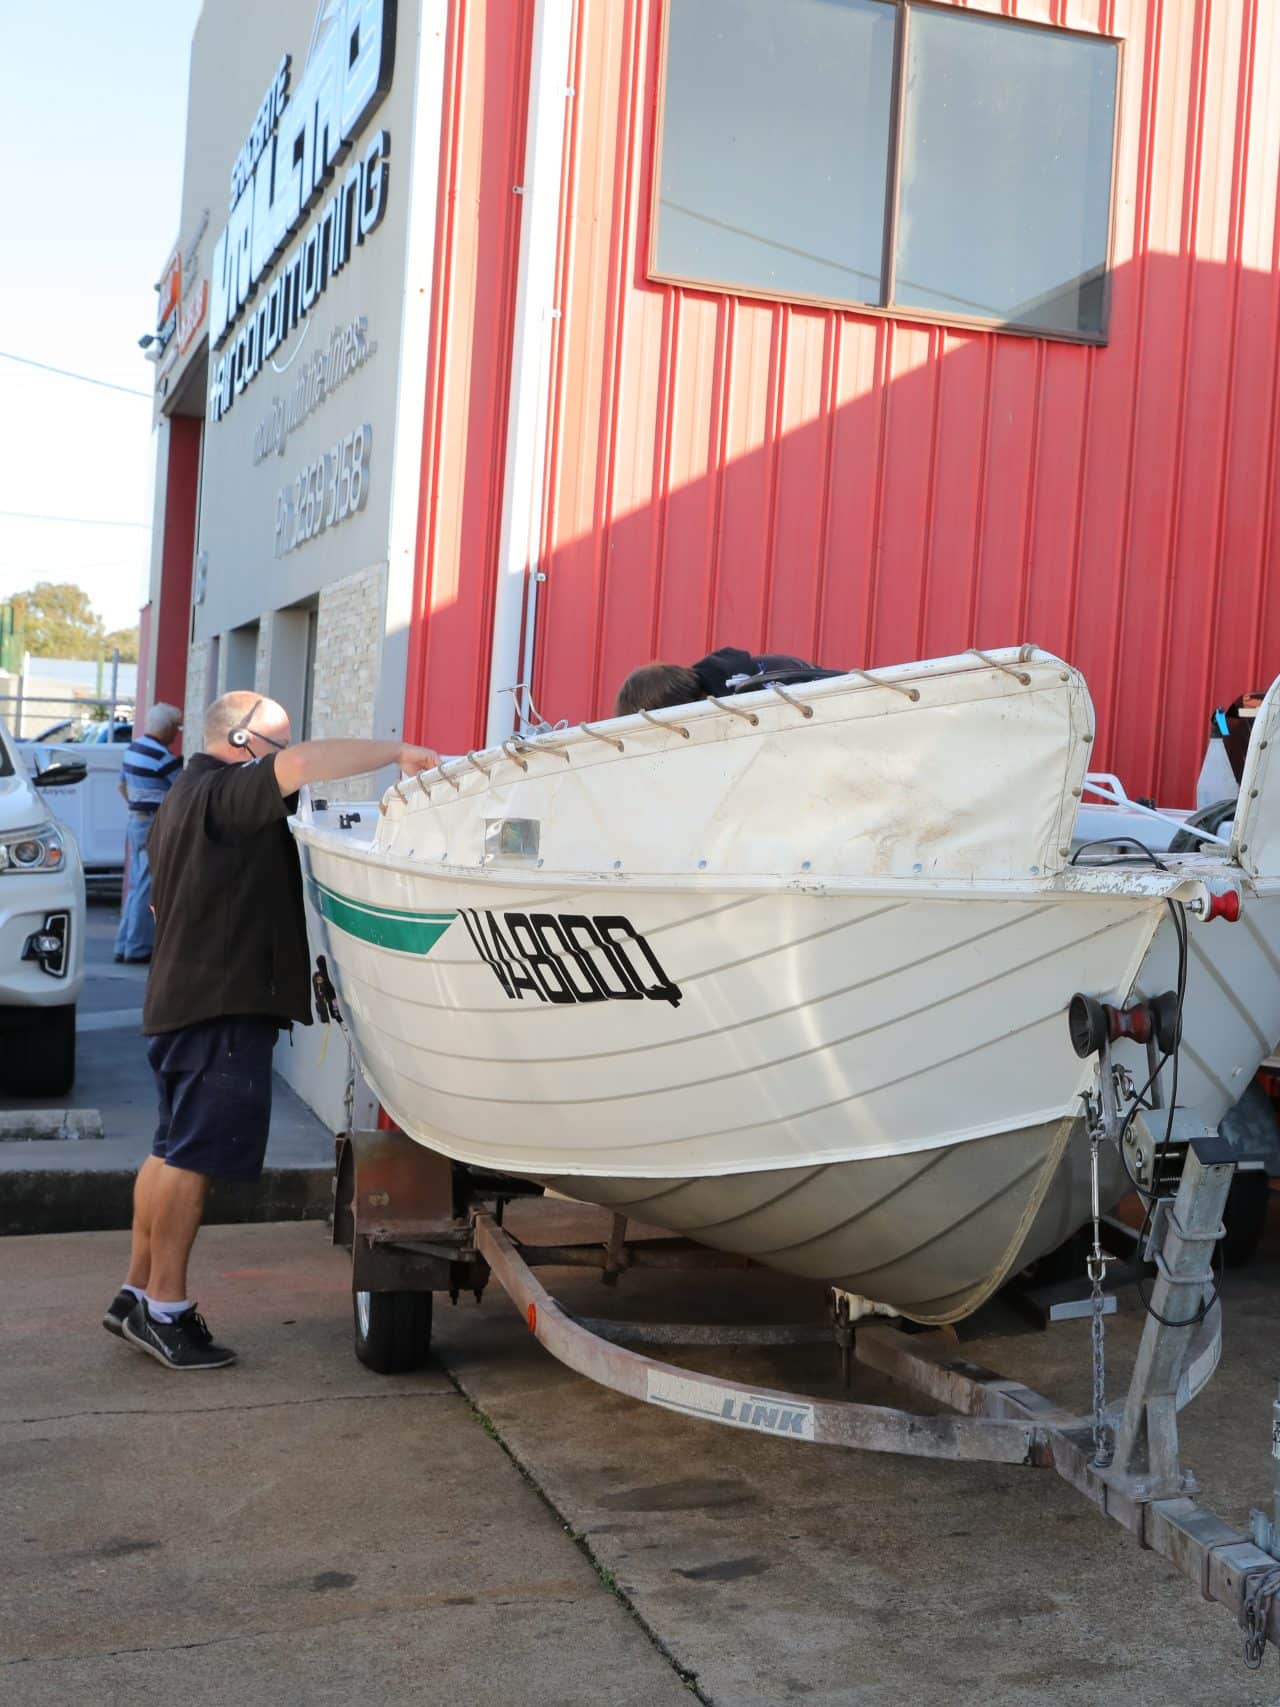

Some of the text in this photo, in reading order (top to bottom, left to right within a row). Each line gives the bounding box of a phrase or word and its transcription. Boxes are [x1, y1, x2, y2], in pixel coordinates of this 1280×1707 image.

[326, 422, 373, 528] 3158
[457, 908, 683, 1008] VA800Q
[720, 1397, 808, 1434] LINK
